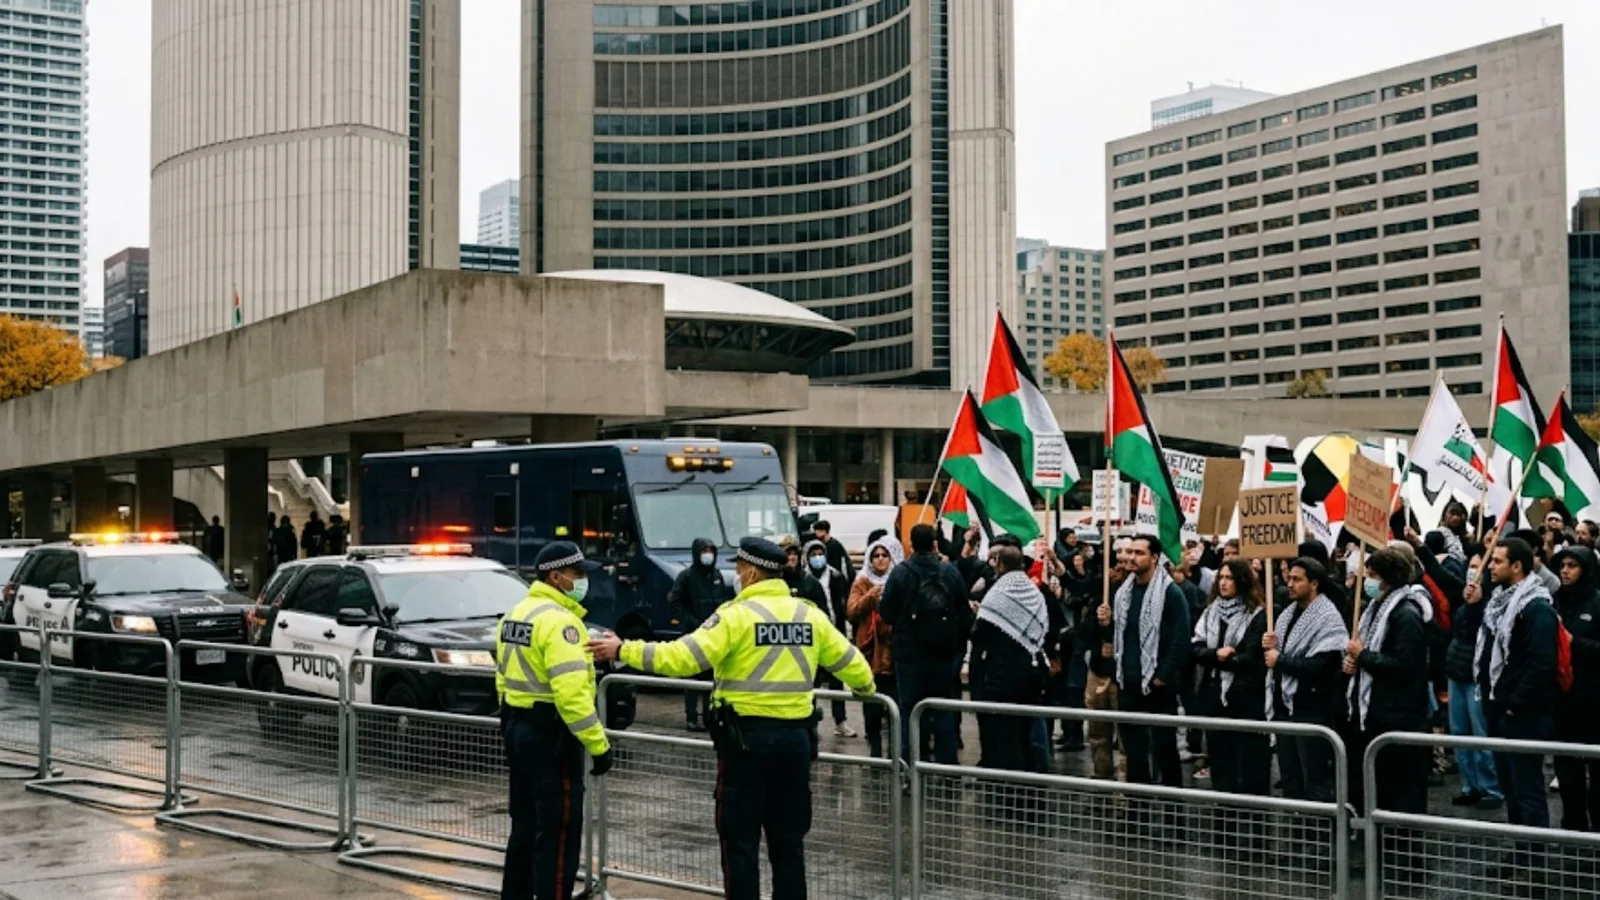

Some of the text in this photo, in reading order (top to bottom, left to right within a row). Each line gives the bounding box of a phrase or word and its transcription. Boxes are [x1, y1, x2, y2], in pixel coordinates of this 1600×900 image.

[1241, 493, 1294, 517] JUSTICE
[1241, 522, 1296, 546] FREEDOM
[757, 624, 811, 644] POLICE
